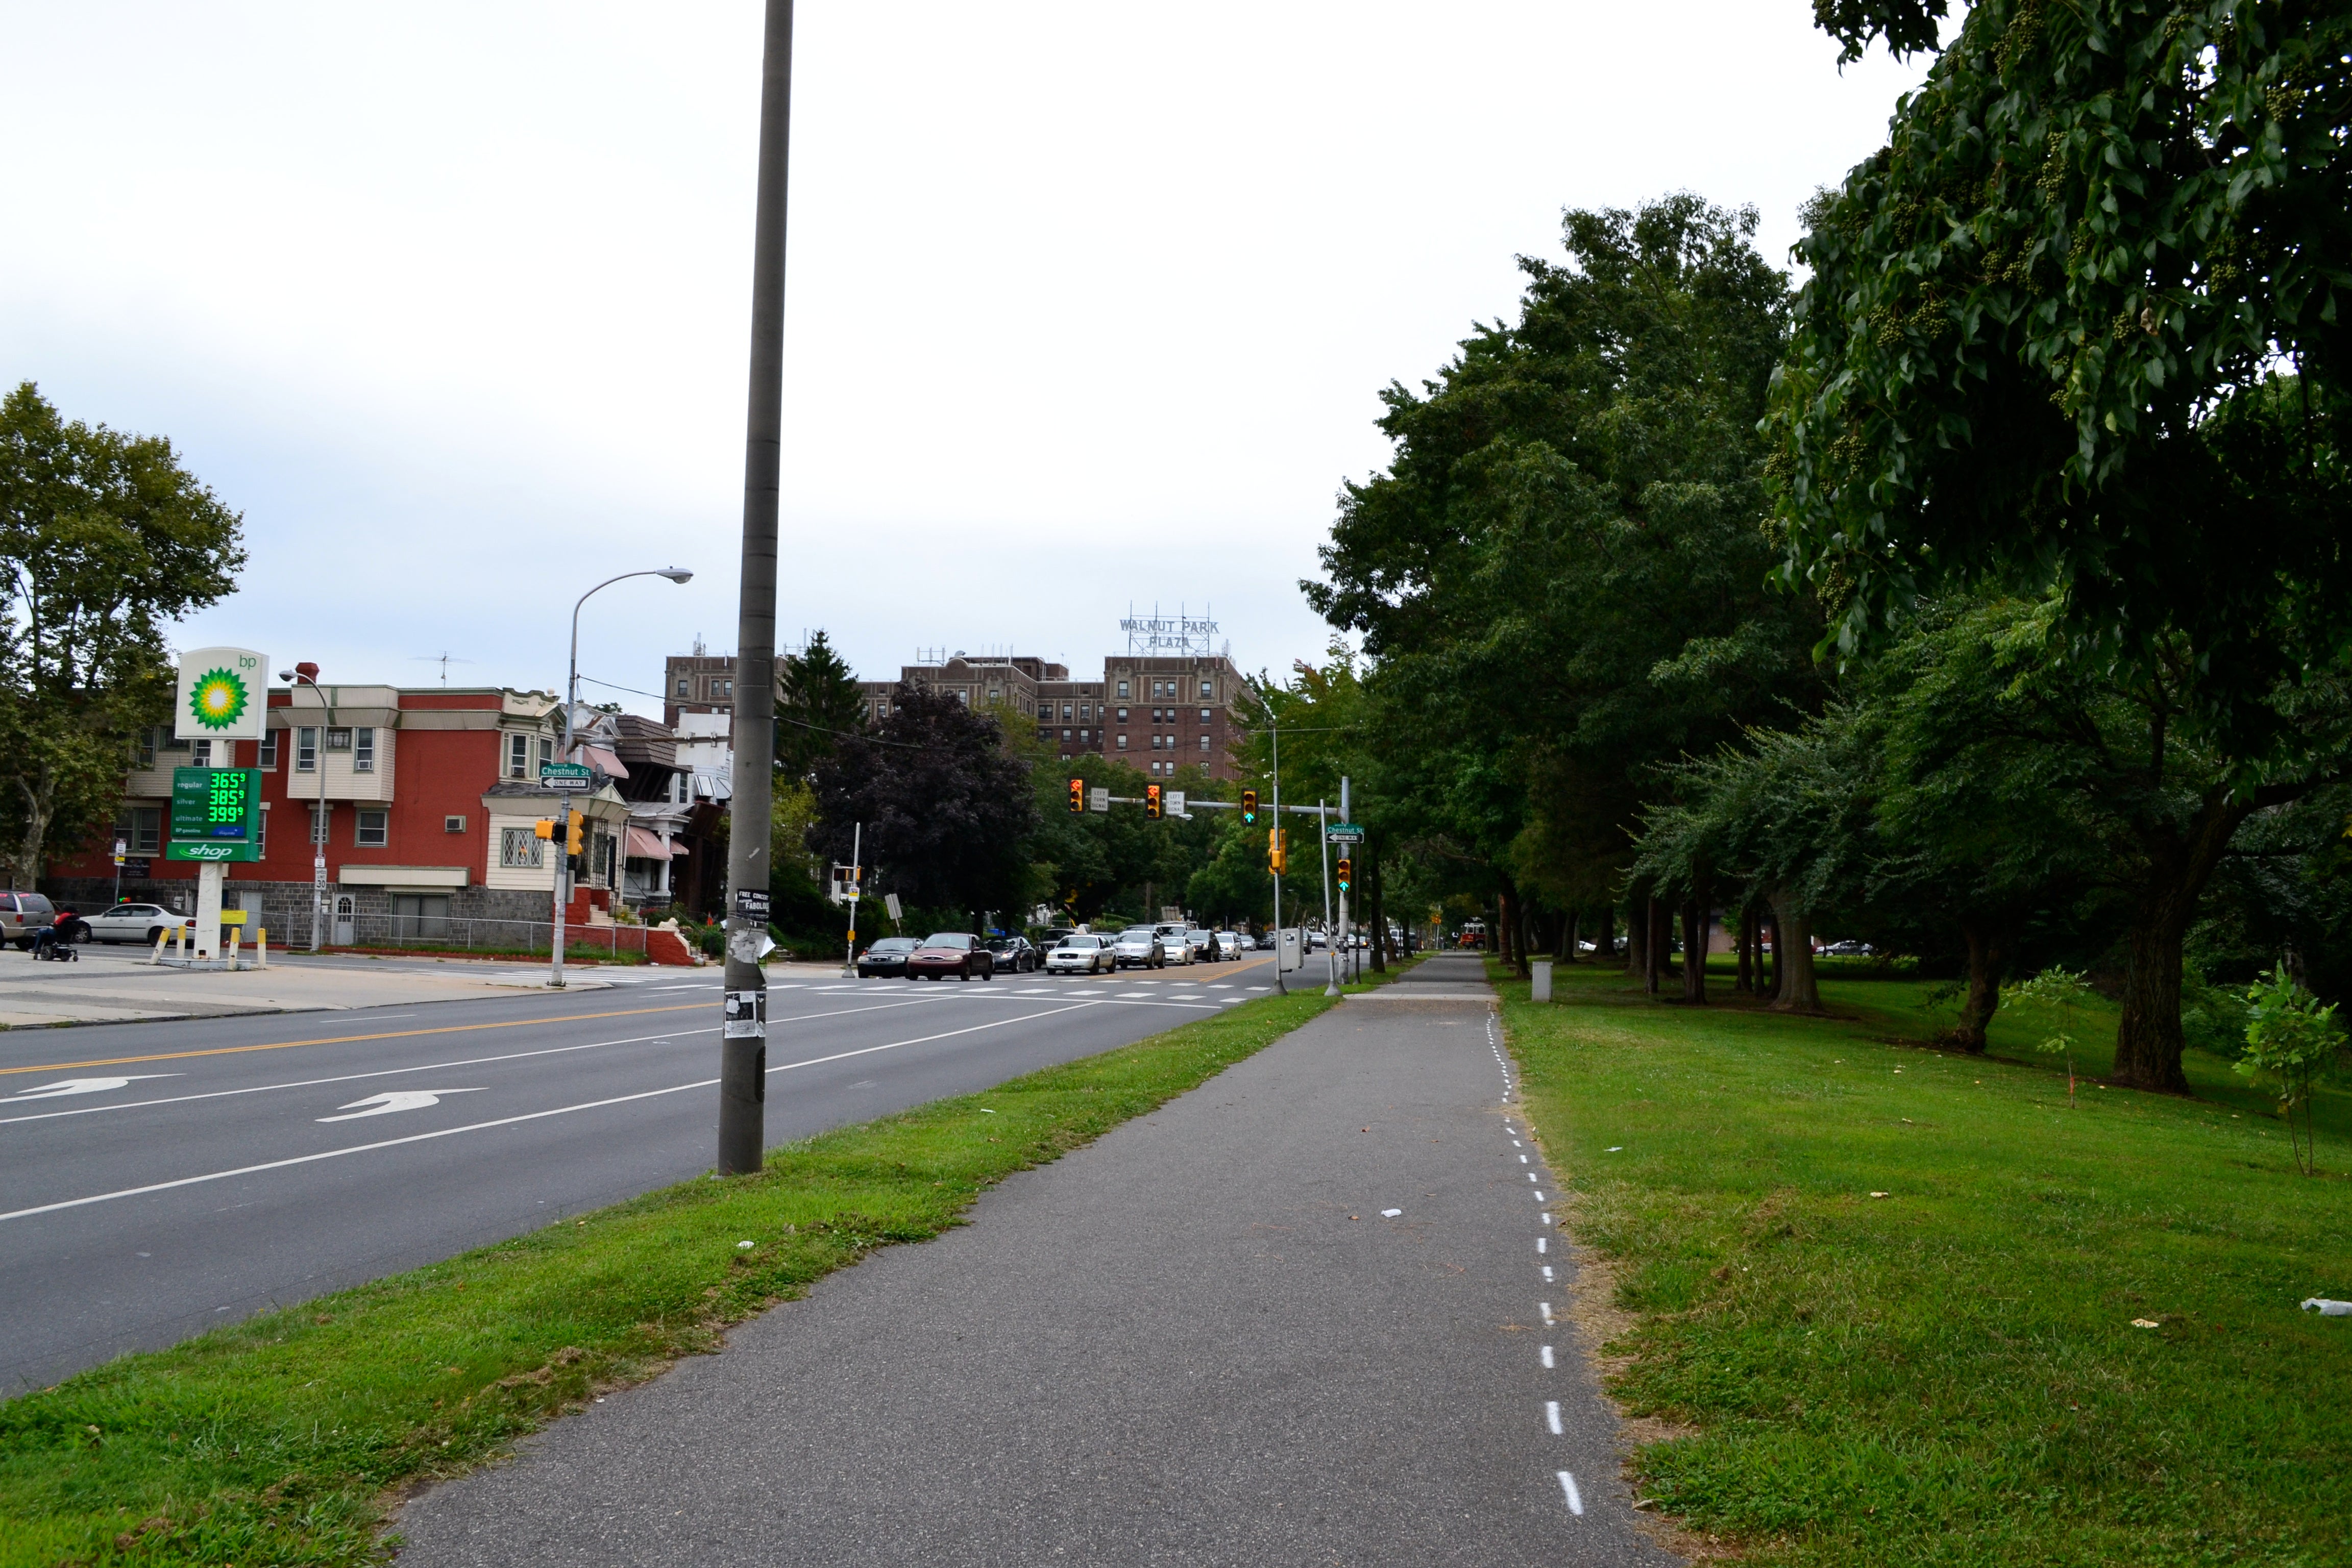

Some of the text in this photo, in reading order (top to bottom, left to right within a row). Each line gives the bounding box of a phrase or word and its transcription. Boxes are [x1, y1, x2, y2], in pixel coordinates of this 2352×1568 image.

[1119, 620, 1220, 634] WALNUT PARK
[1149, 636, 1191, 648] PLAZA
[239, 654, 257, 670] bp
[542, 767, 578, 775] Chestnut
[189, 844, 232, 859] shop
